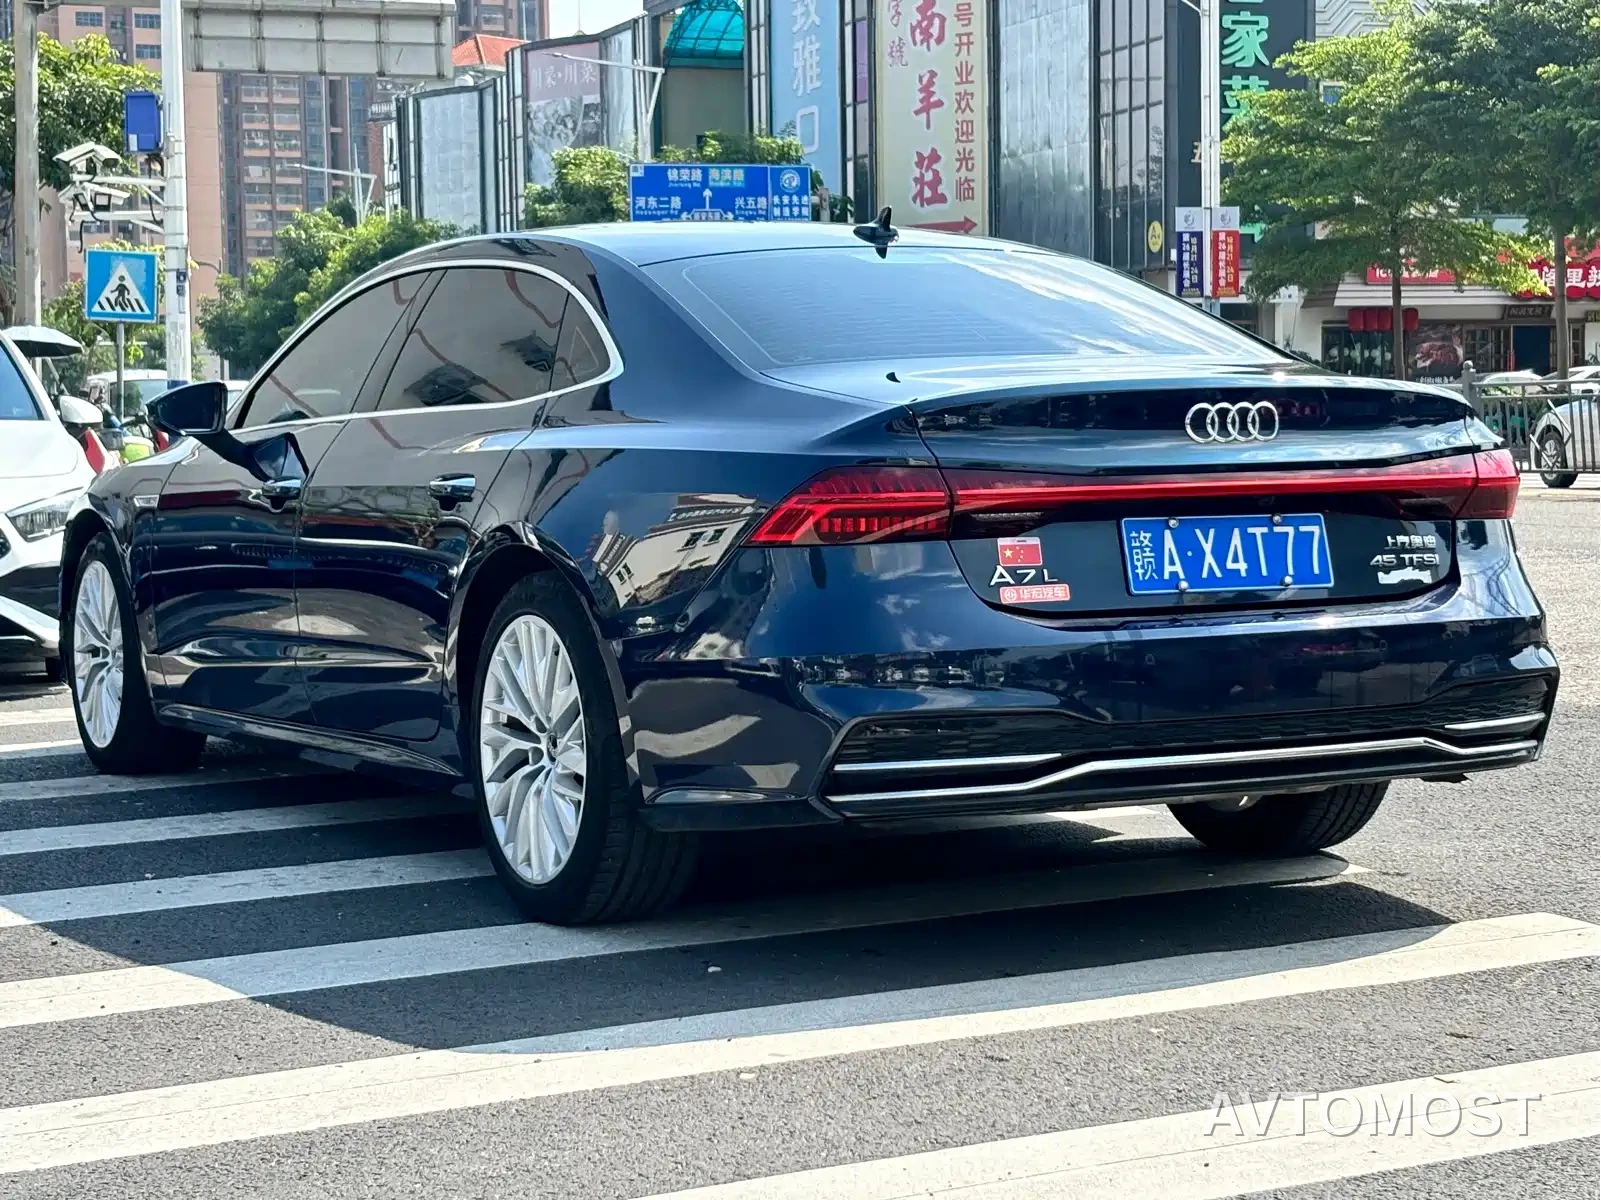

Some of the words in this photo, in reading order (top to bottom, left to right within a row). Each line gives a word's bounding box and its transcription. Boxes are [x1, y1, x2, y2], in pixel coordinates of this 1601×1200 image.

[953, 2, 975, 201] 号开业欢迎光临
[635, 196, 681, 209] 河东二路
[735, 197, 767, 209] 兴五路
[1129, 526, 1320, 581] 赣A·X4T77
[1370, 555, 1397, 567] 45
[1400, 553, 1440, 566] TFSI
